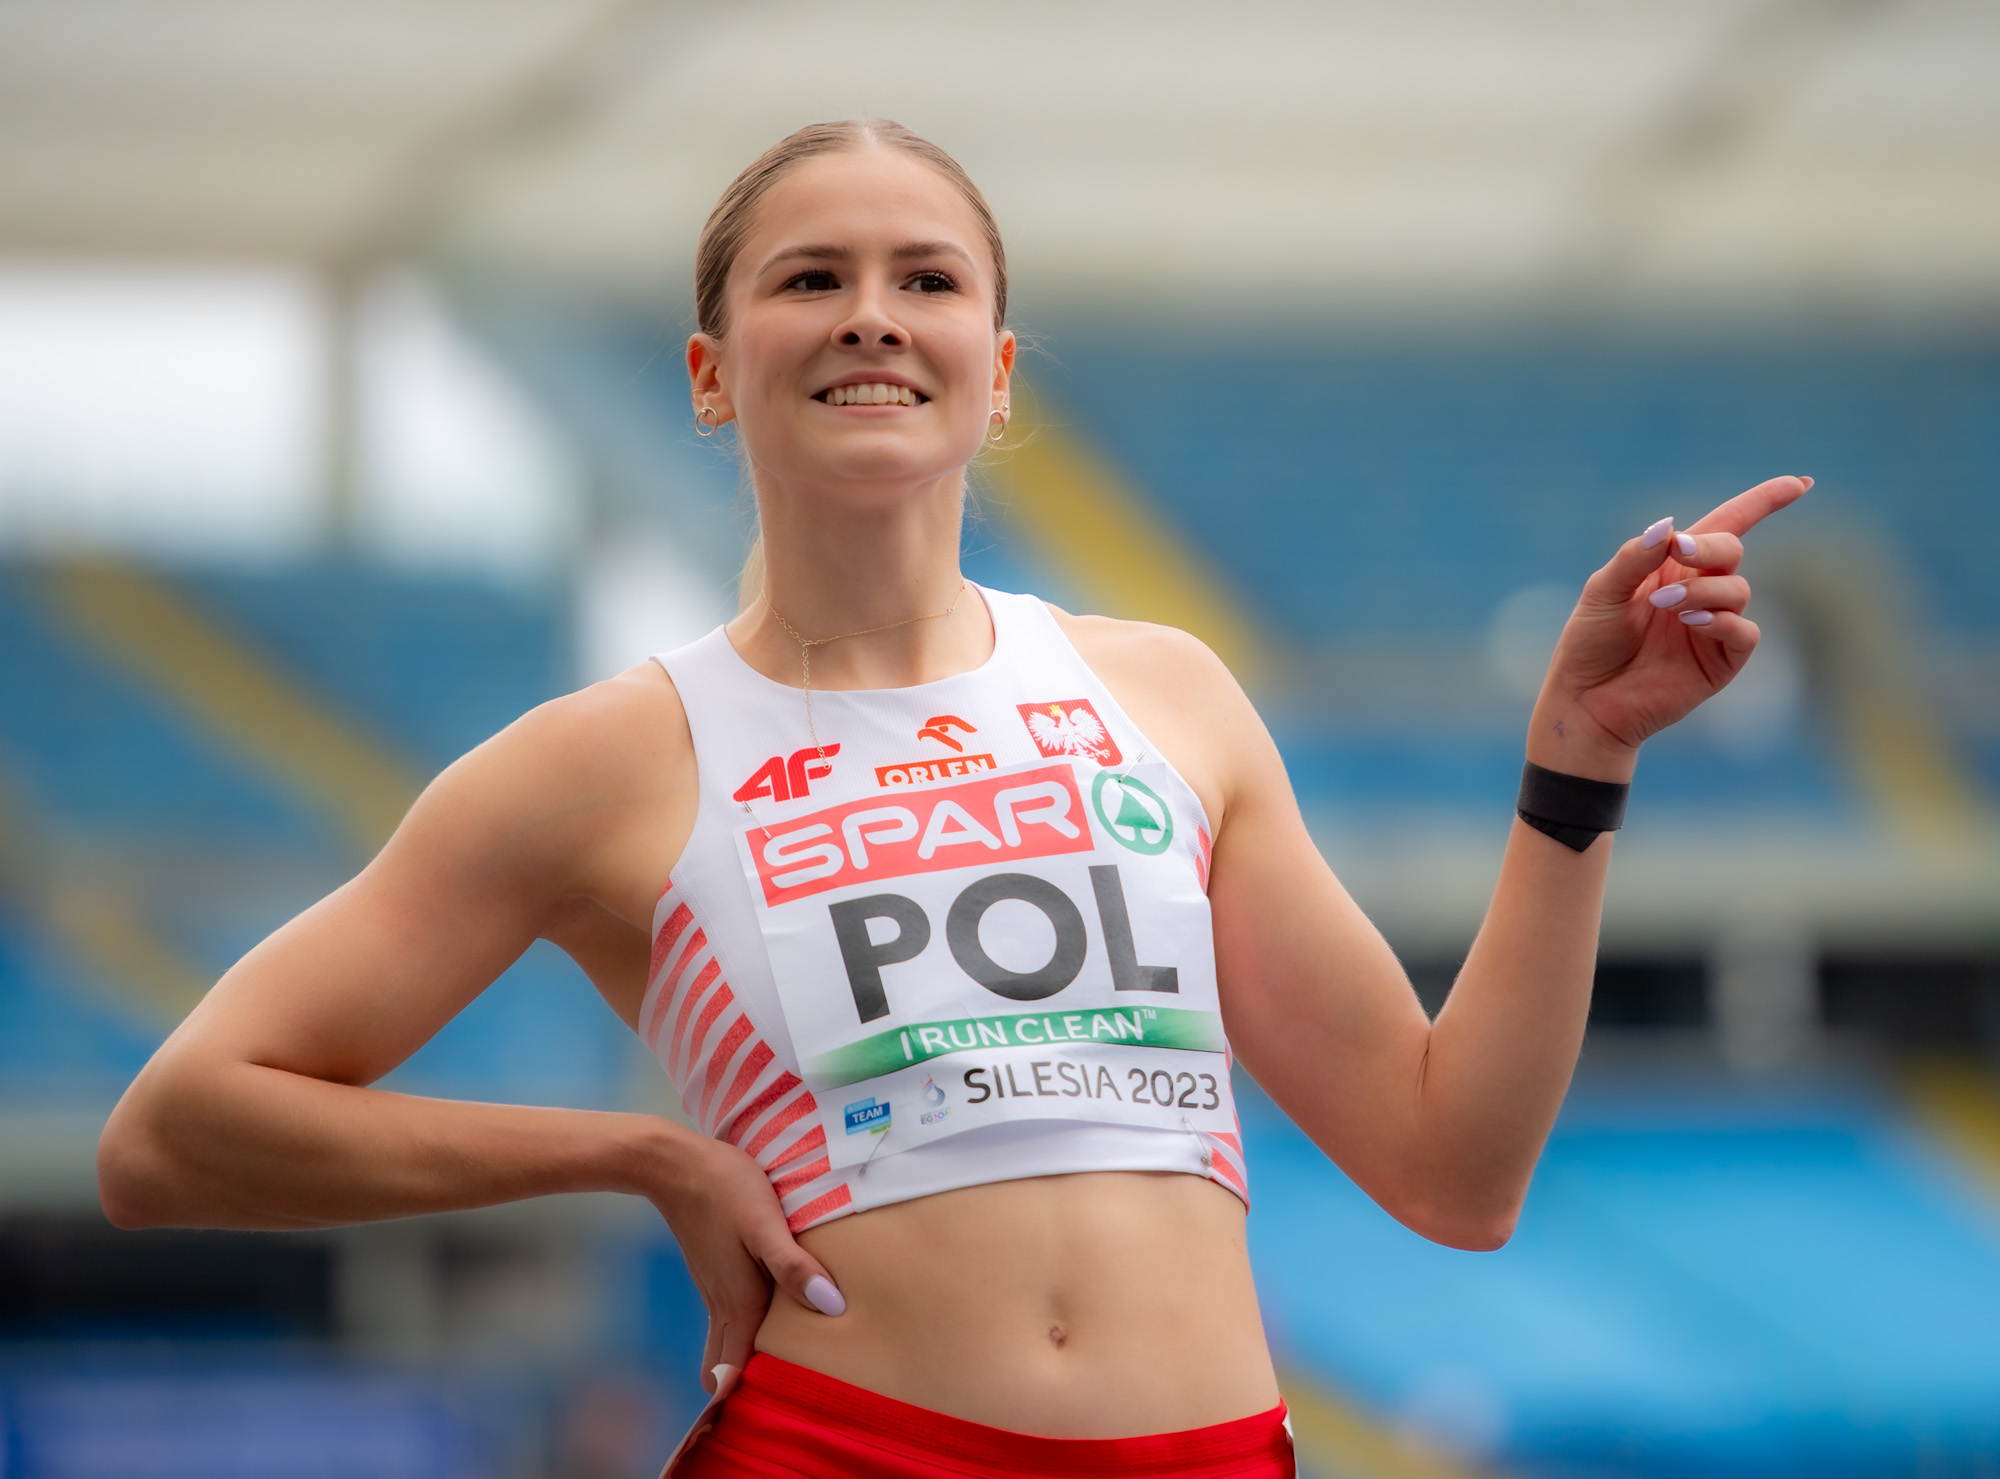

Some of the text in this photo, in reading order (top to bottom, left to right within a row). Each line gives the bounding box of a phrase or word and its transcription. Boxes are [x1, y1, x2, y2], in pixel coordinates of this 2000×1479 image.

[733, 743, 840, 802] 4F
[763, 781, 1080, 889] SPAR
[828, 864, 1179, 1025] POL
[900, 1031, 914, 1061] I
[918, 1020, 1009, 1054] RUN
[964, 1062, 1220, 1110] SILESIA 2023
[852, 1106, 883, 1124] TEAM
